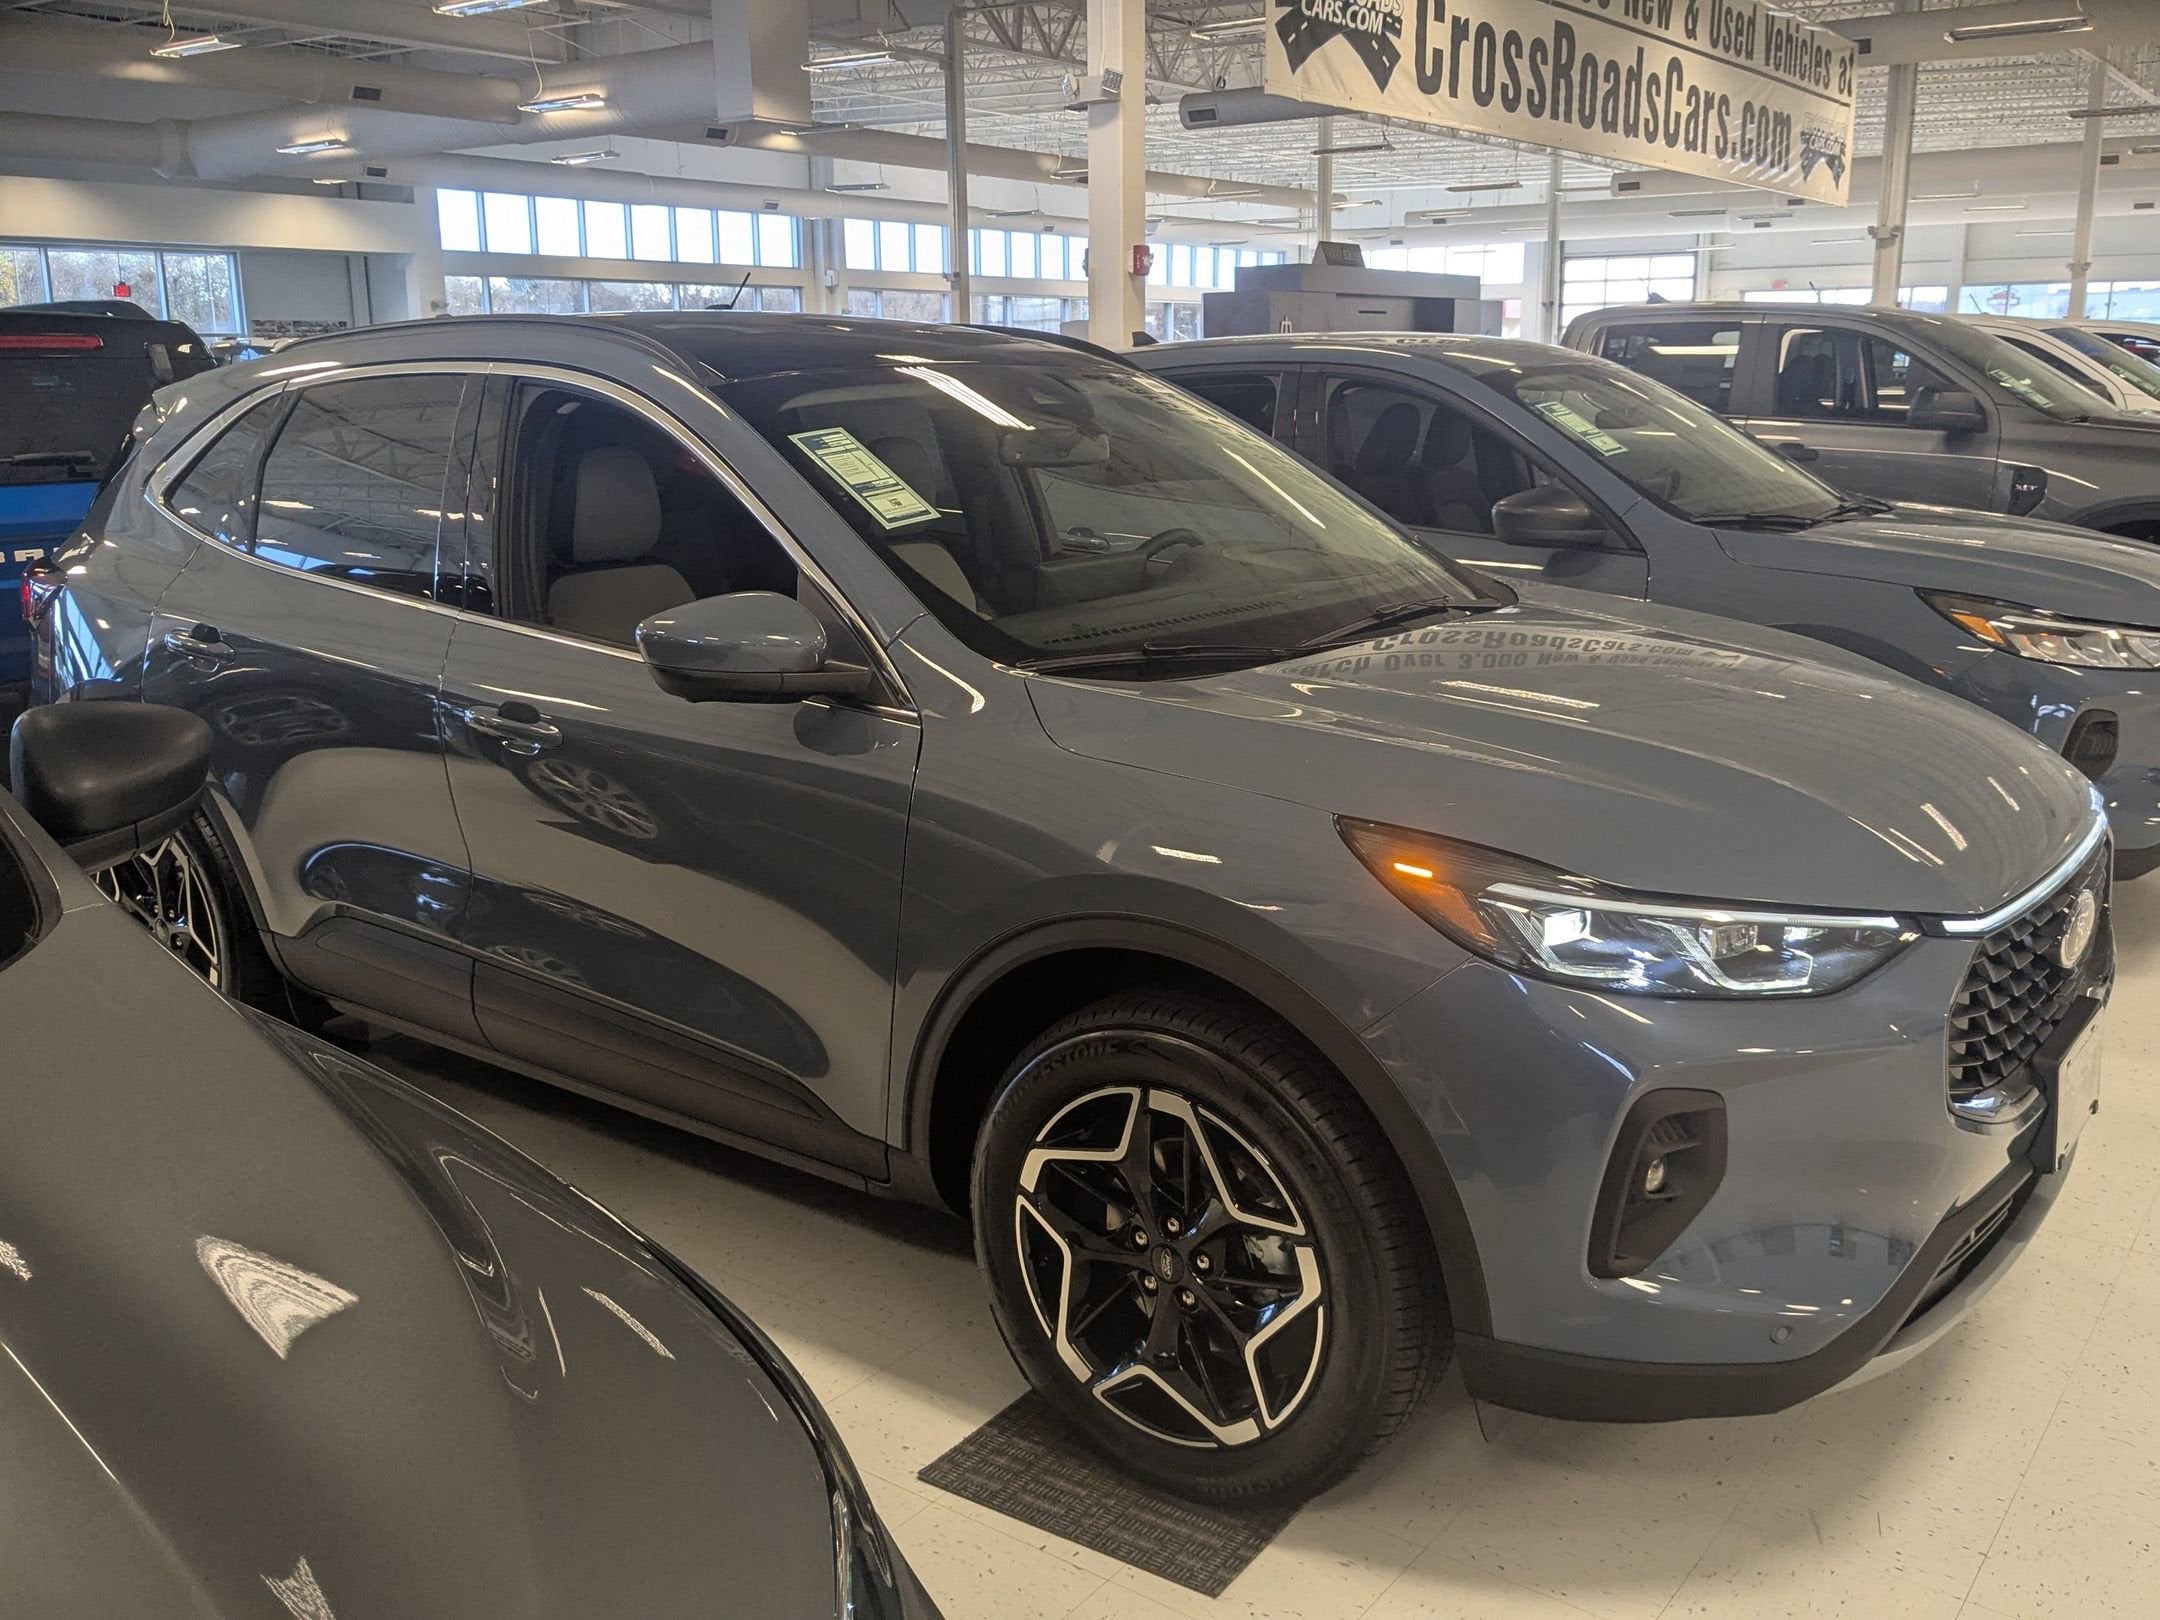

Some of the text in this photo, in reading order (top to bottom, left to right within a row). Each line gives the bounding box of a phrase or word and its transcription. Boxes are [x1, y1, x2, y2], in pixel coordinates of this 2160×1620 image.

[1301, 0, 1384, 35] CARS.COM
[1709, 0, 1756, 61] Used
[1764, 12, 1832, 90] Vehicles
[1838, 48, 1855, 98] at
[1414, 0, 1793, 173] CrossRoadsCars.com
